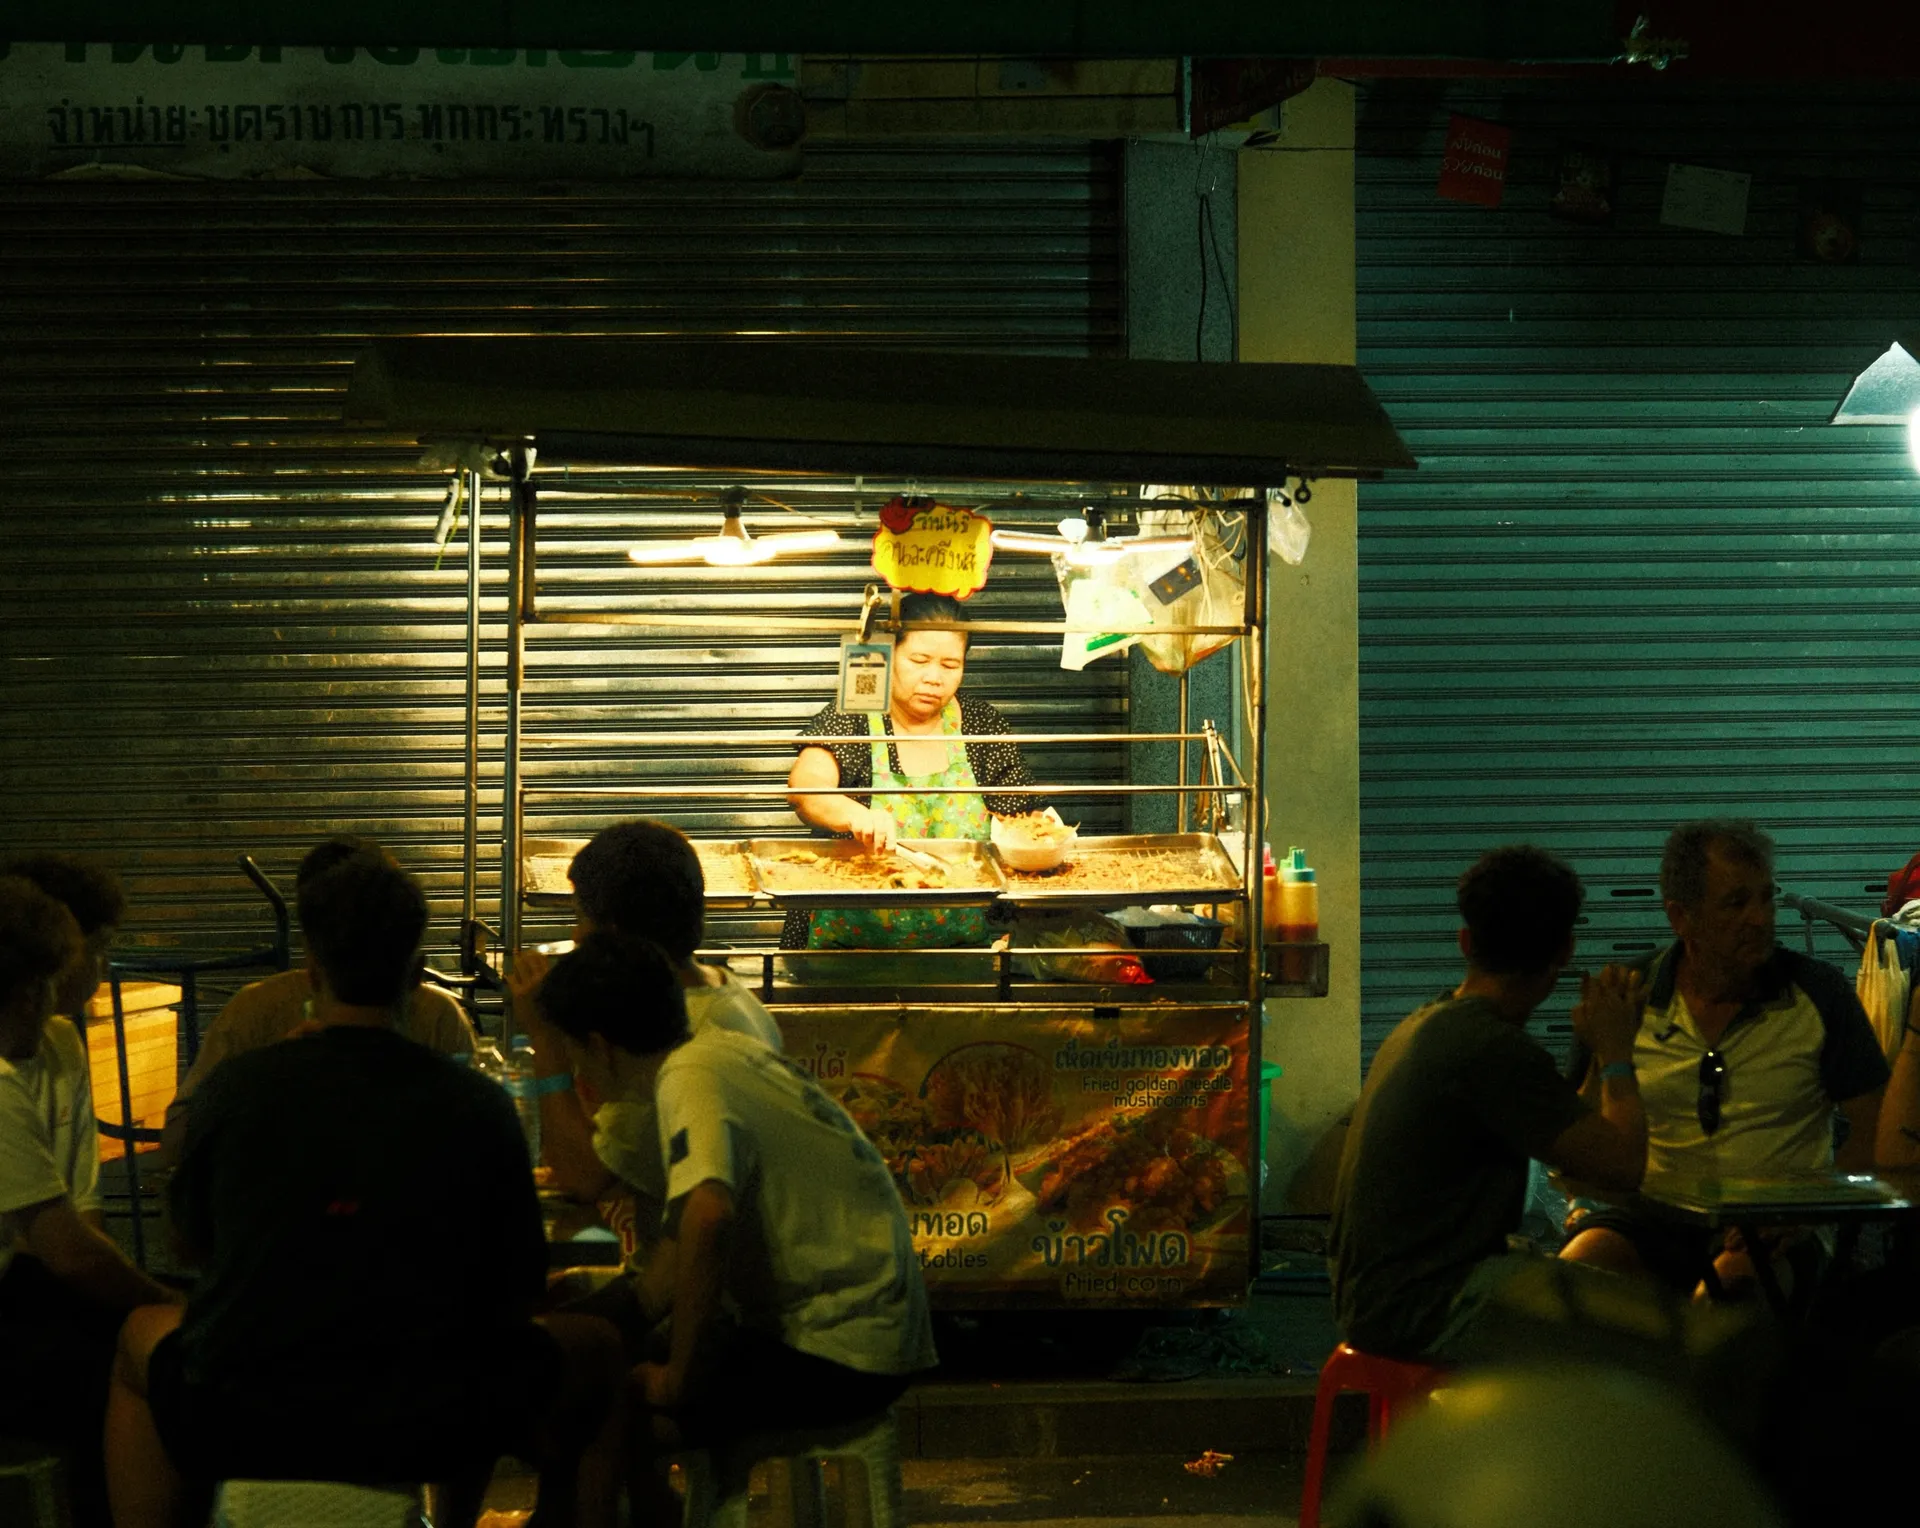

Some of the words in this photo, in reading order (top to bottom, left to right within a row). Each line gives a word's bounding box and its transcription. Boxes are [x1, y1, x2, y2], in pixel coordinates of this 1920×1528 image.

[1083, 1076, 1119, 1092] Fried
[1126, 1076, 1178, 1096] golden
[1183, 1074, 1232, 1092] needle
[1114, 1092, 1207, 1108] mushrooms
[1032, 1209, 1187, 1267] ข้าวโพด
[1065, 1272, 1118, 1292] fried
